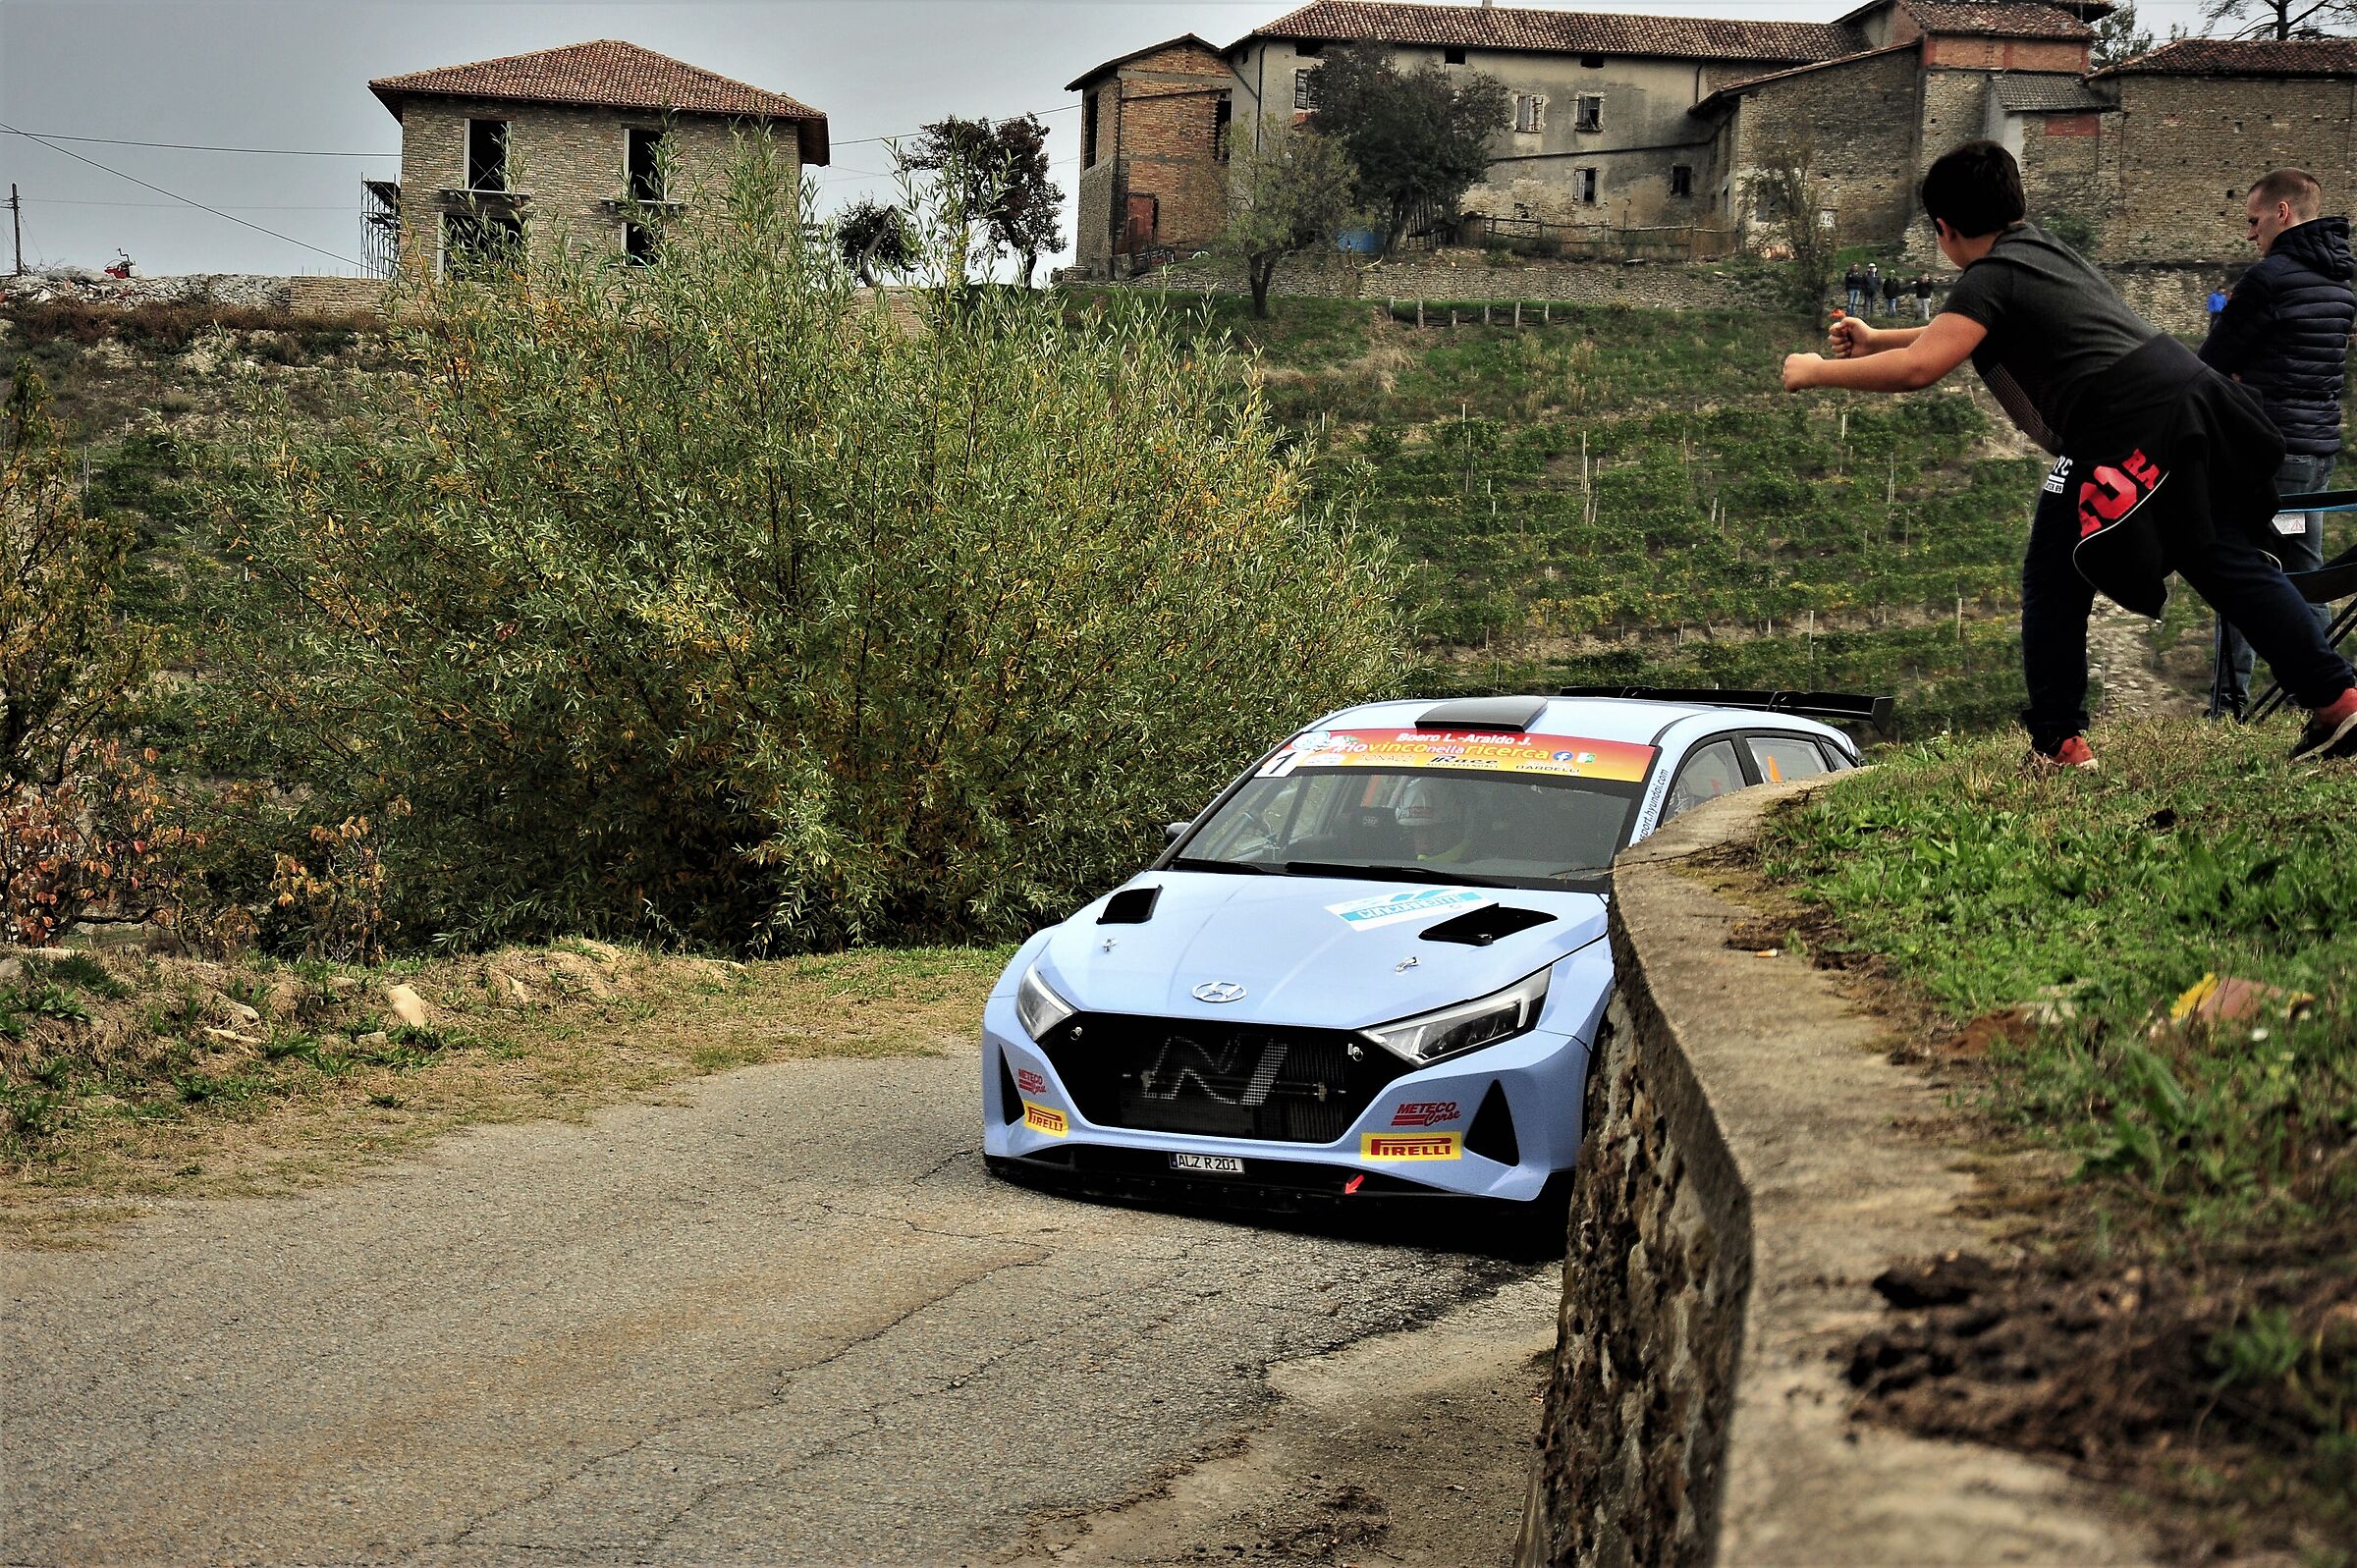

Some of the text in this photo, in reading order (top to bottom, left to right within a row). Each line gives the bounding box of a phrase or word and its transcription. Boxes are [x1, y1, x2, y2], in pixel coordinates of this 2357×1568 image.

[1396, 732, 1442, 742] Boero
[1518, 736, 1532, 746] J.
[1269, 751, 1297, 775] 1
[1017, 1068, 1043, 1085] METECO
[1398, 1102, 1457, 1114] METECO
[1027, 1106, 1064, 1132] PIRELLI
[1423, 1110, 1461, 1127] Corse
[1370, 1137, 1453, 1156] PIRELLI
[1178, 1155, 1238, 1171] ALZ R 201
